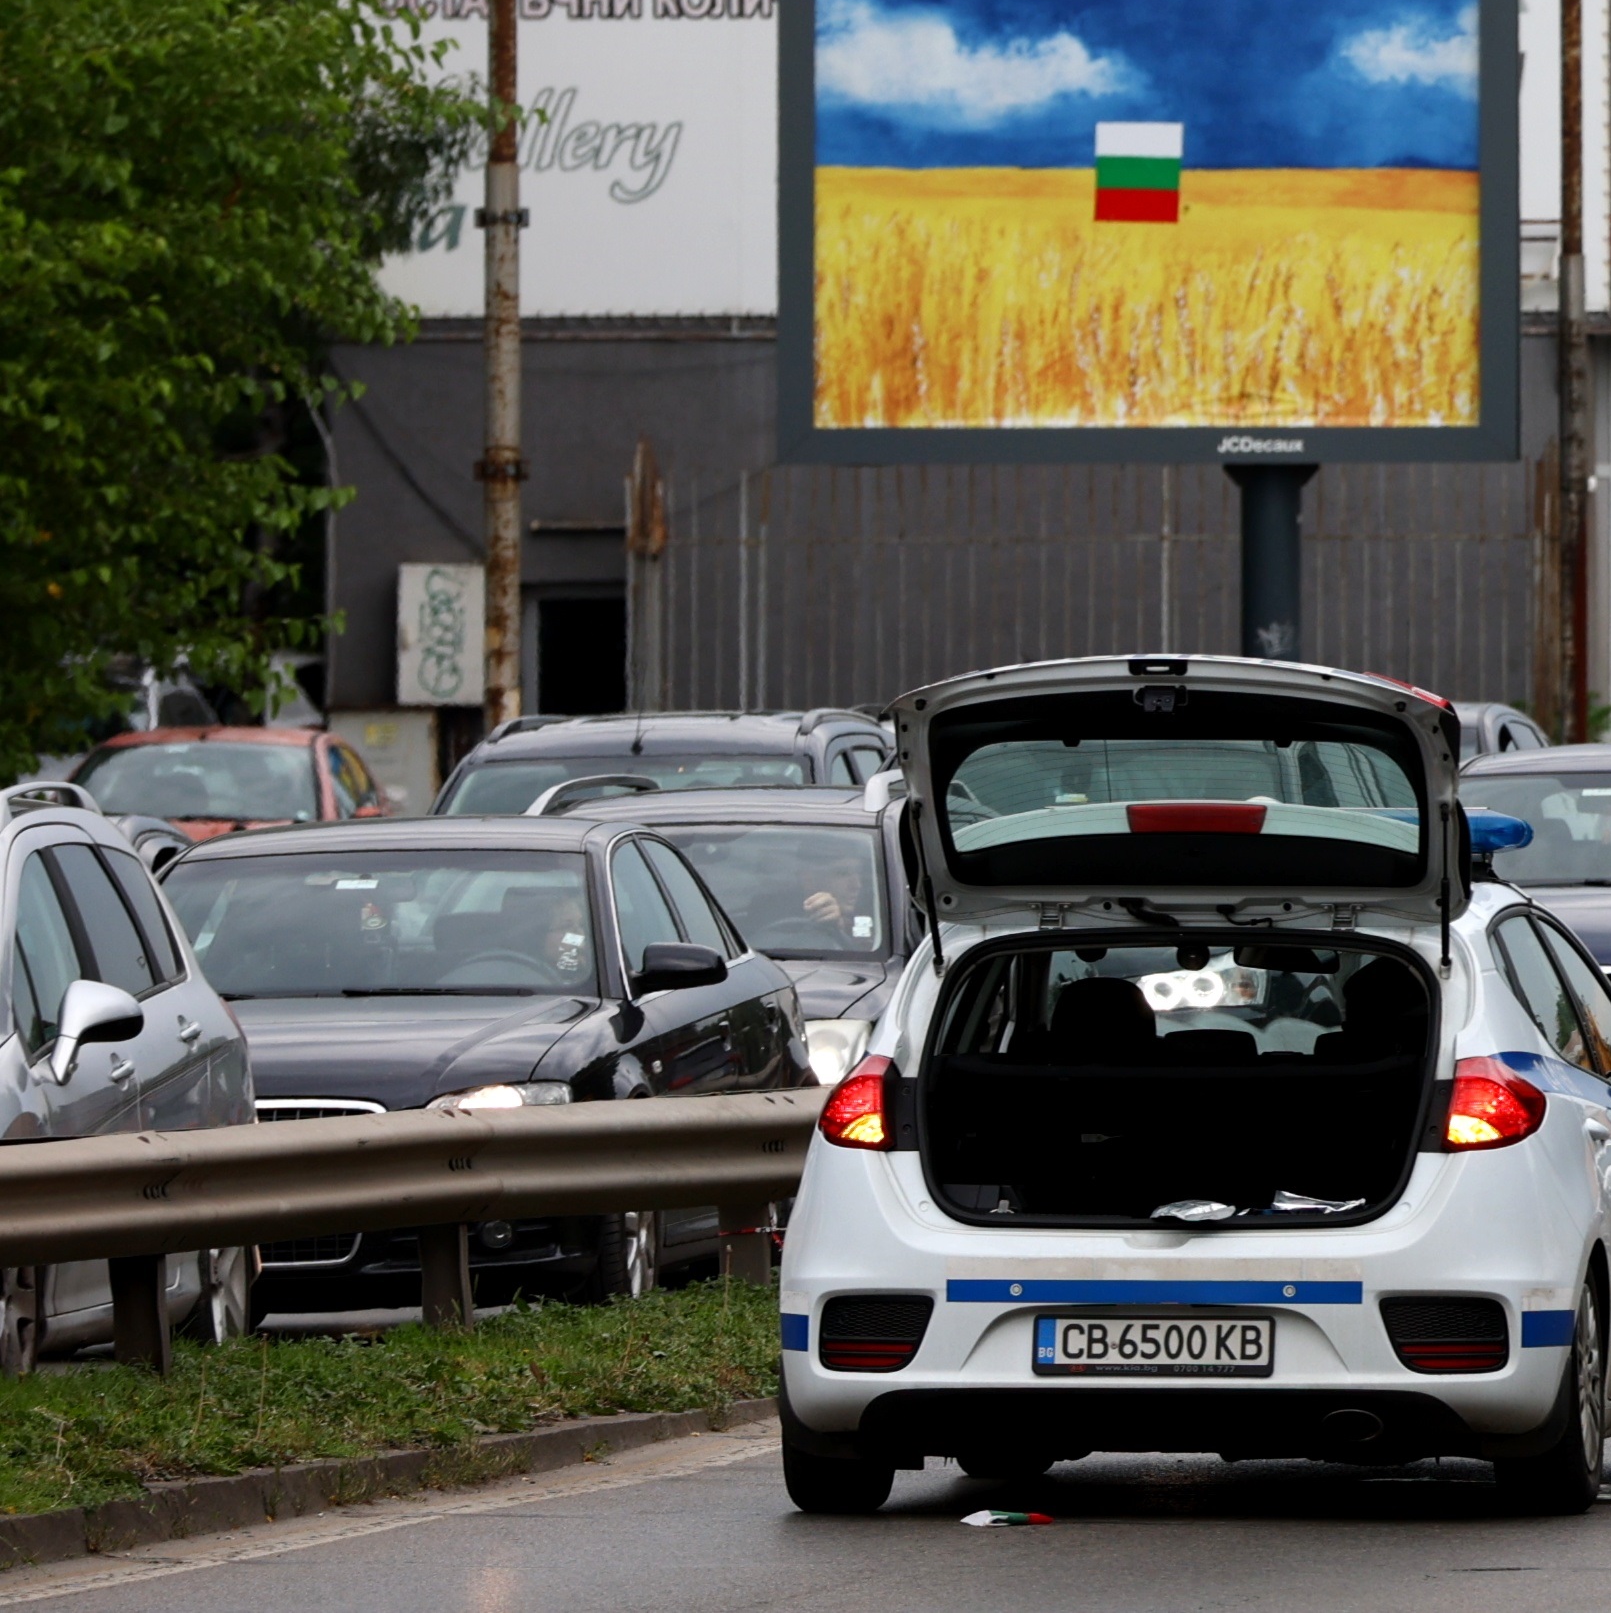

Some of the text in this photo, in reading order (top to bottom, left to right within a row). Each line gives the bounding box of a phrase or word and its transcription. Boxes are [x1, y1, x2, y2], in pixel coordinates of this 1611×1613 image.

[1217, 435, 1304, 454] JCDecaux
[1062, 1323, 1263, 1360] CB 6500 KB
[1038, 1347, 1054, 1358] BG
[1095, 1365, 1158, 1373] www.kia.bg
[1173, 1365, 1199, 1373] 0700
[1202, 1365, 1214, 1373] 14
